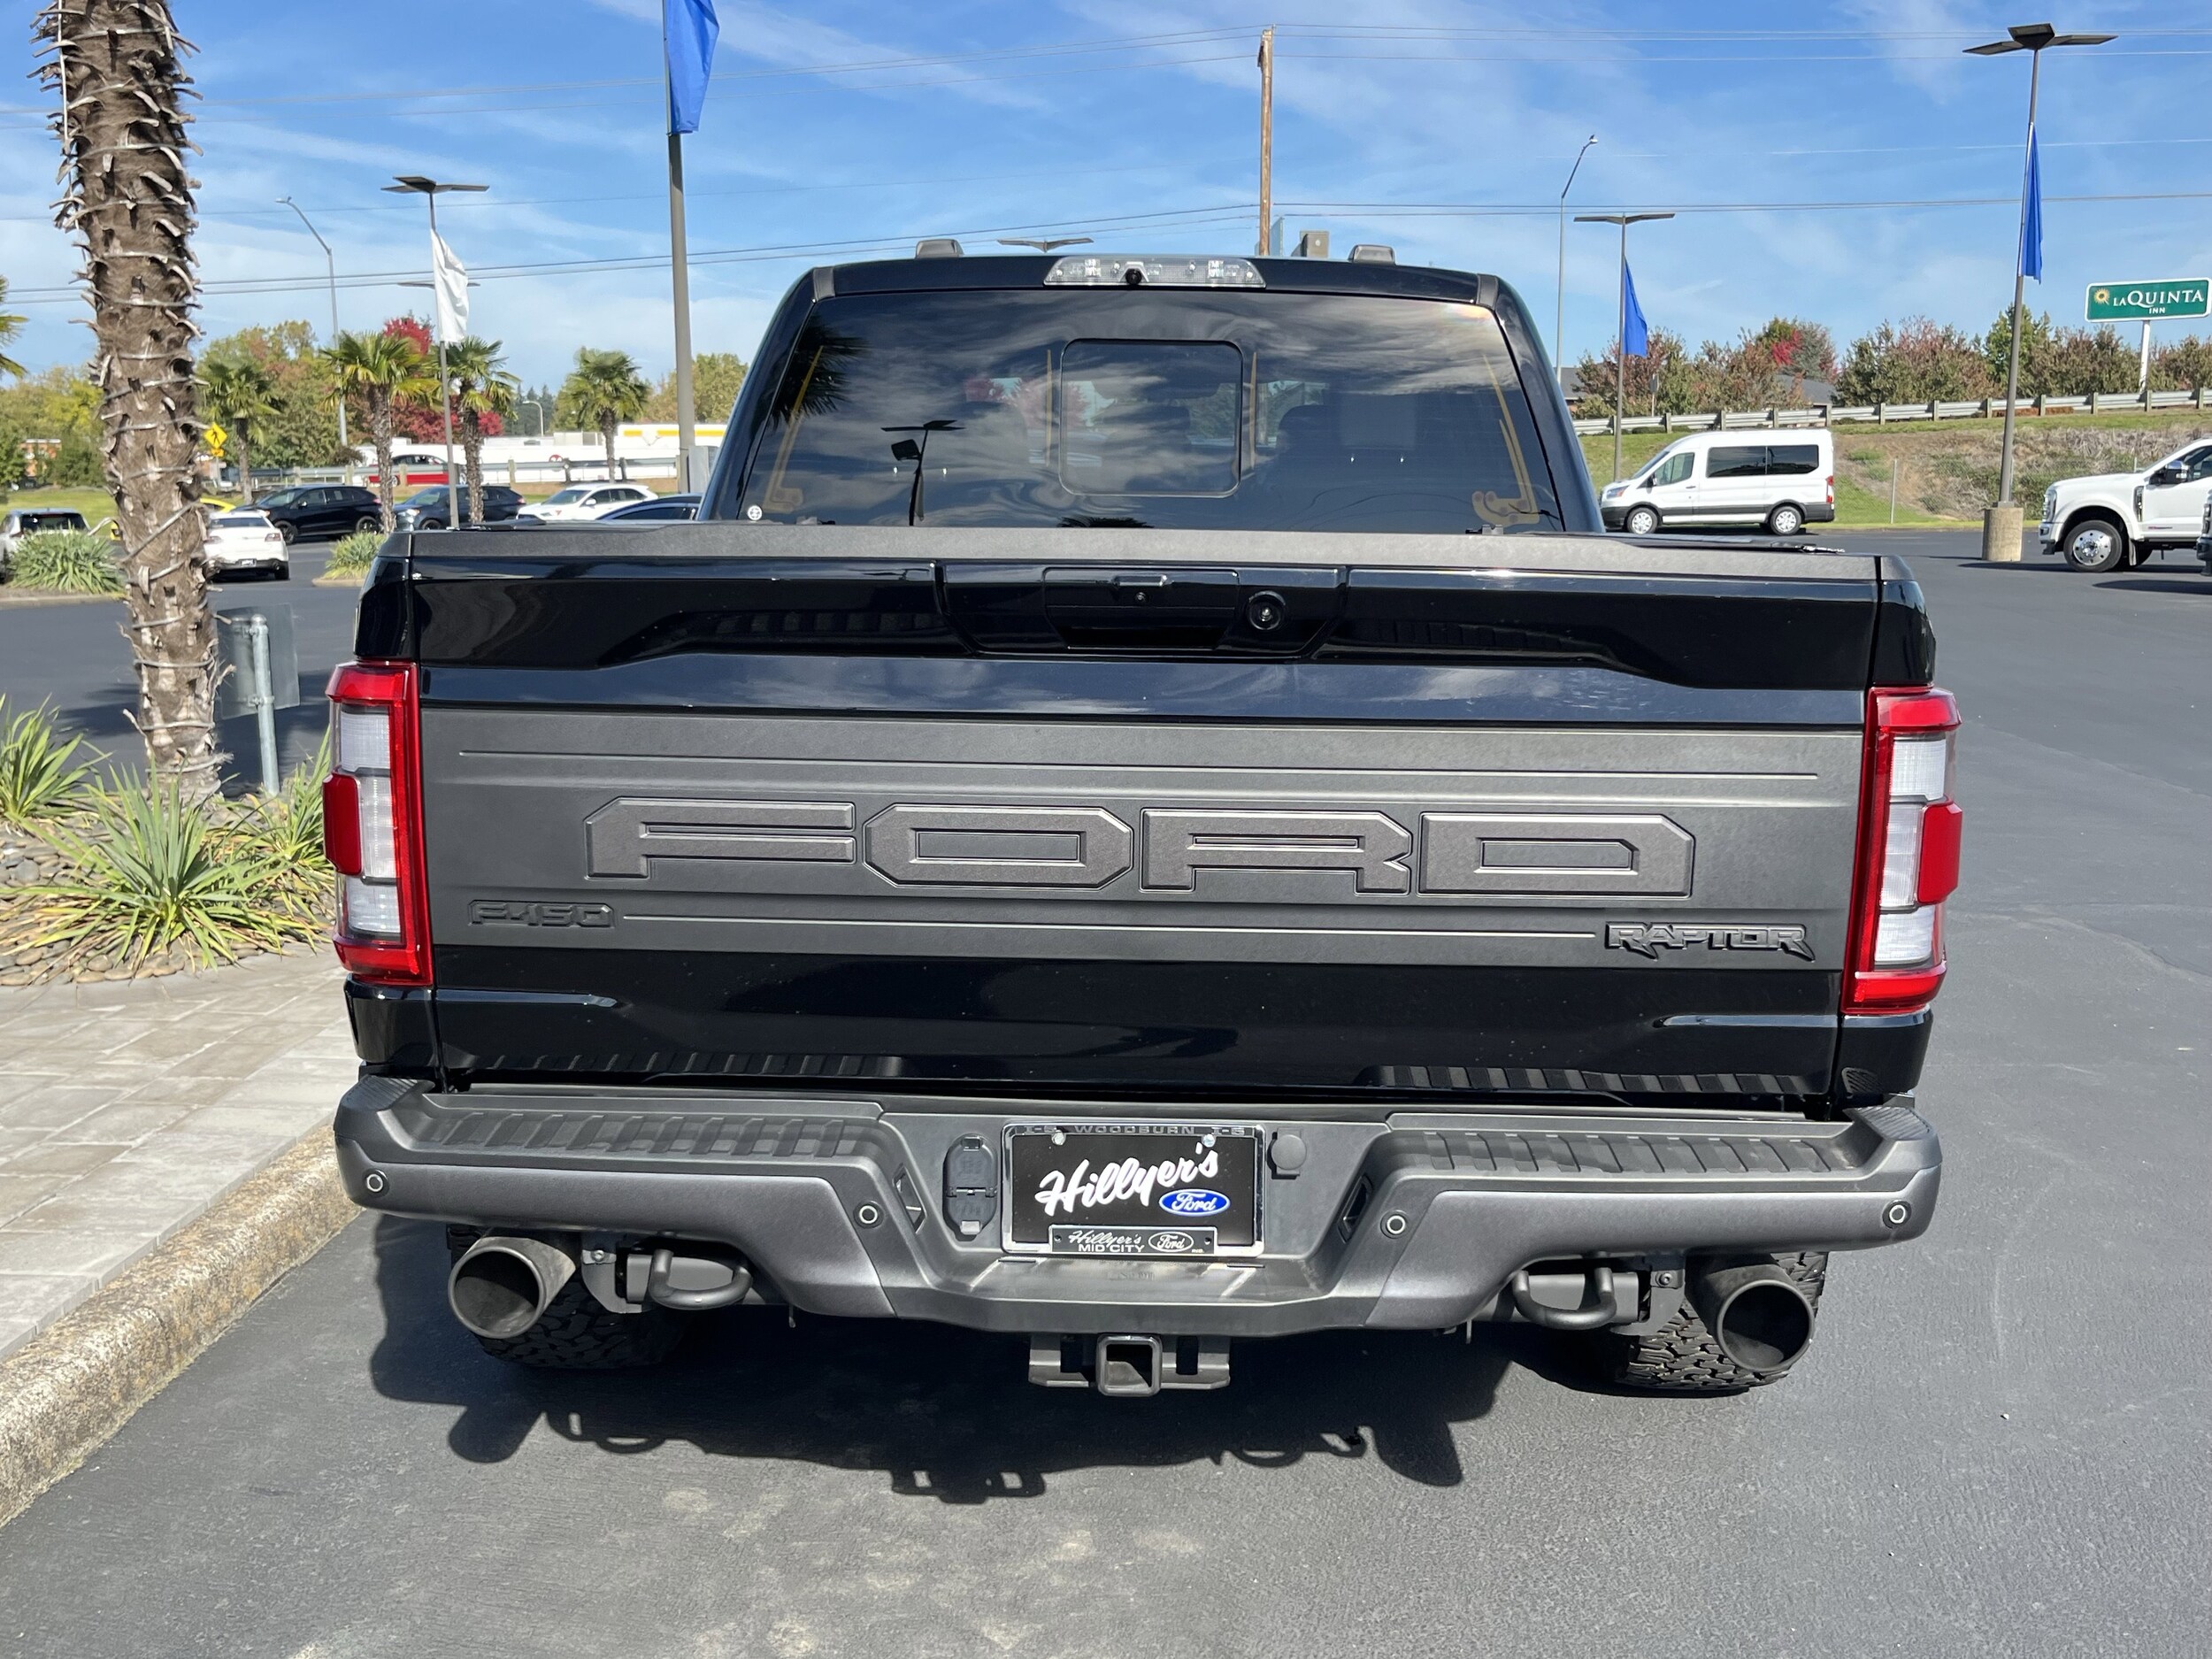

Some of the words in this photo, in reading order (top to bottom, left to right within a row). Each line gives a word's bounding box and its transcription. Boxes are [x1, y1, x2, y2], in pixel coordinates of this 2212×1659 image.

[585, 796, 1694, 898] FORD
[1605, 922, 1816, 962] RAPTOR
[1074, 1125, 1195, 1135] WOODBURN
[1211, 1126, 1246, 1135] I-5
[1034, 1141, 1218, 1217] Hillyer's
[1171, 1190, 1217, 1212] Ford
[1068, 1230, 1142, 1248] Hillyer's
[1157, 1233, 1185, 1249] Ford
